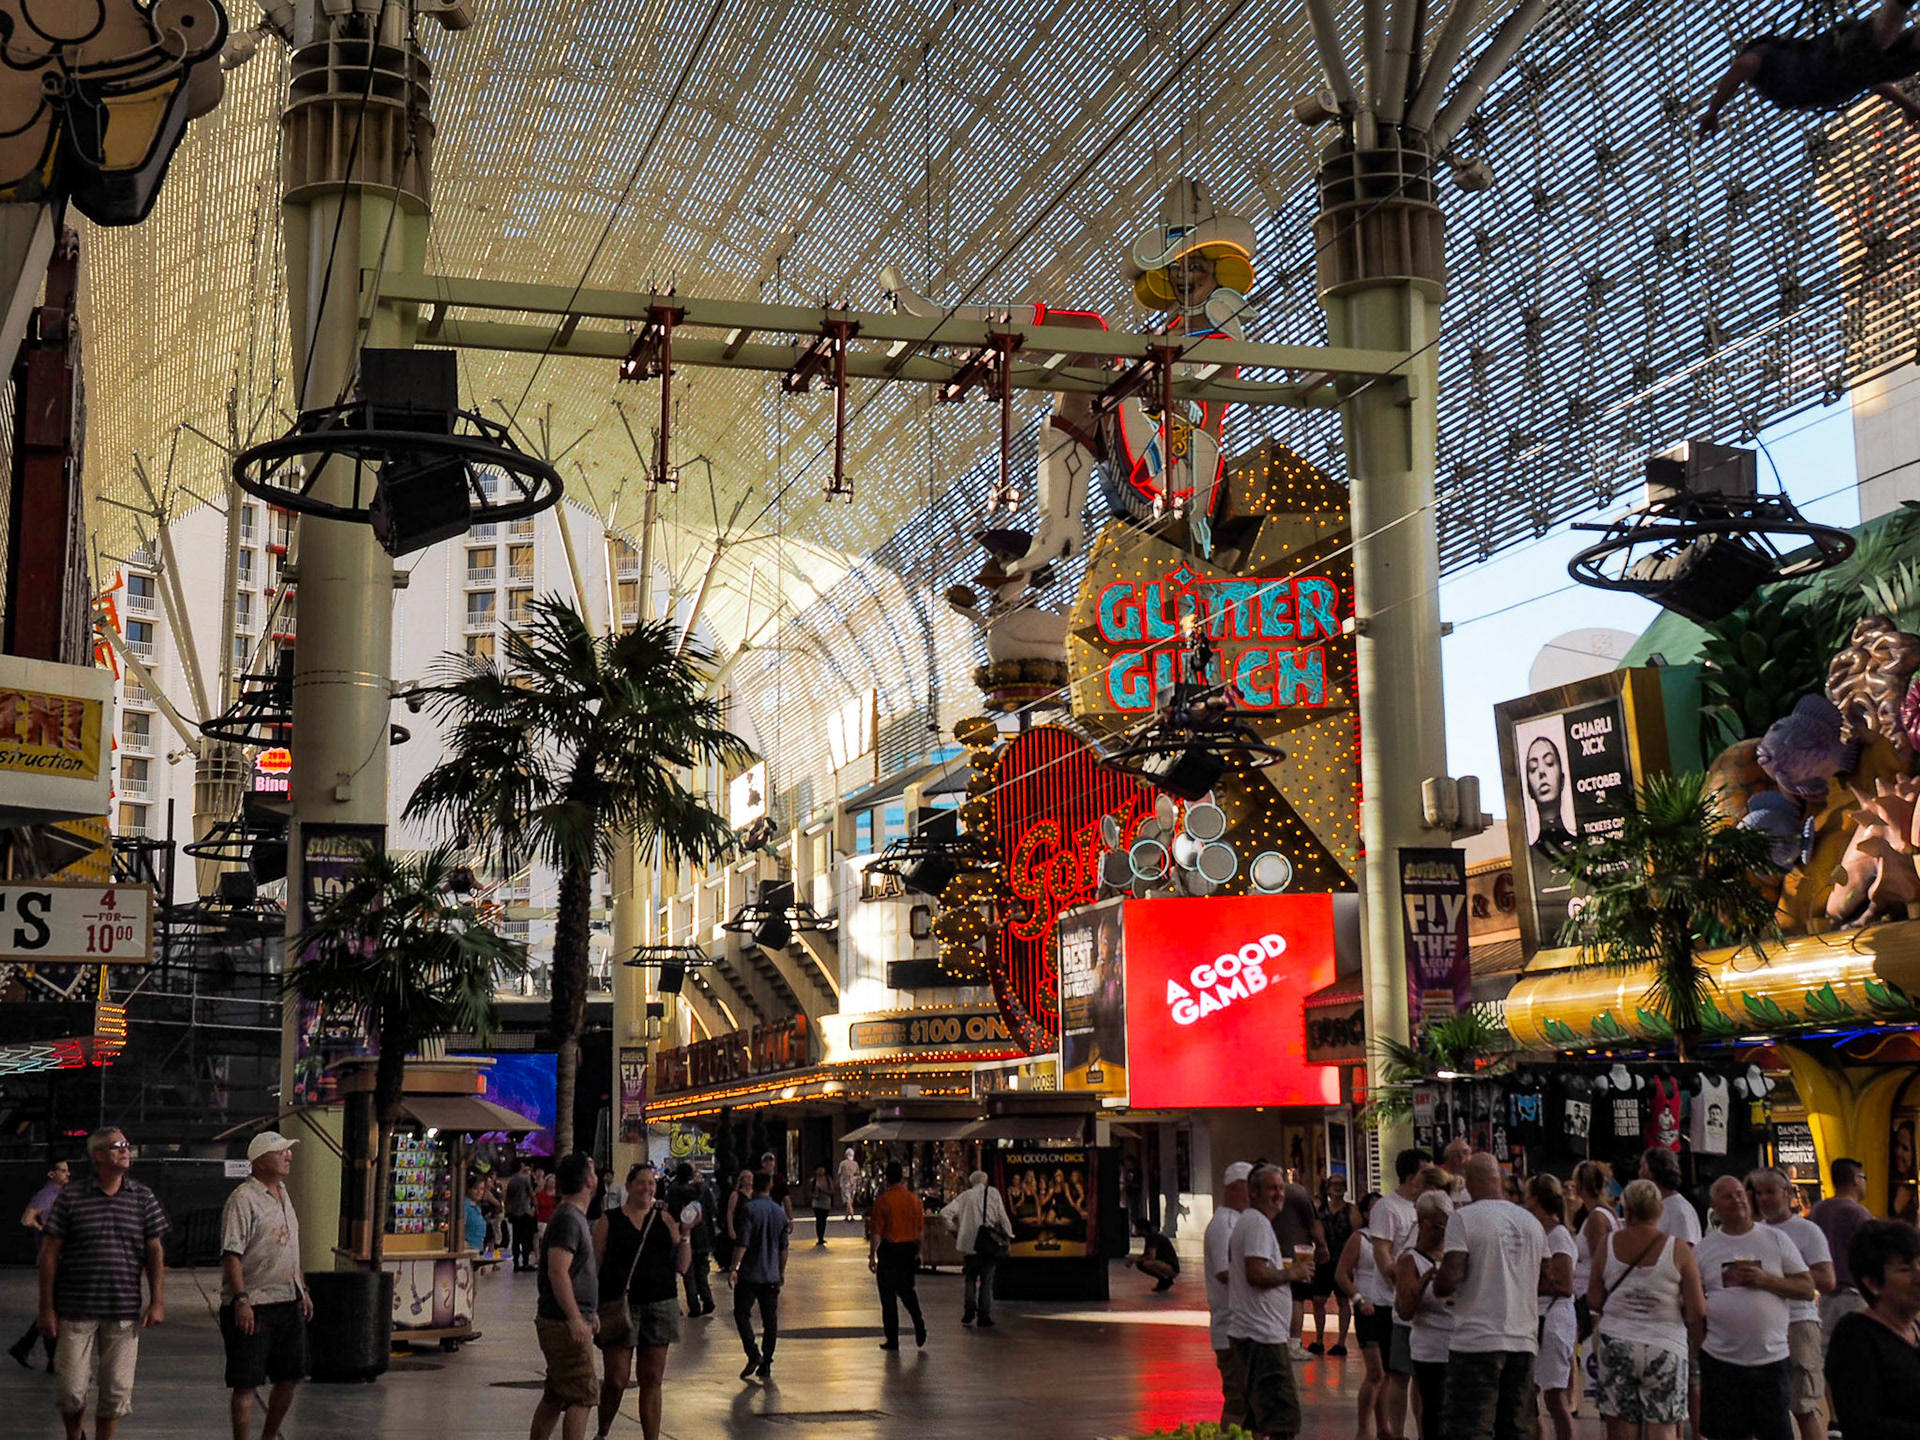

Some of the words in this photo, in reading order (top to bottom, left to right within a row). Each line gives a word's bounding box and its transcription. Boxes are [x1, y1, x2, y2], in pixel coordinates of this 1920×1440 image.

[1570, 716, 1612, 740] CHARLI
[1580, 735, 1606, 756] XCX
[1577, 772, 1621, 792] OCTOBER
[1584, 819, 1612, 834] TICKETS
[1494, 873, 1516, 913] G
[0, 891, 52, 949] S
[100, 890, 117, 910] 4
[99, 913, 122, 922] FOR
[911, 905, 931, 939] C
[1404, 894, 1466, 934] FLY
[1063, 942, 1093, 974] BEST
[1412, 935, 1458, 957] THE
[1167, 979, 1190, 1005] A
[1190, 934, 1287, 989] GOOD
[910, 1017, 961, 1043] $100
[621, 1064, 647, 1080] FLY
[1778, 1141, 1814, 1151] DEALING
